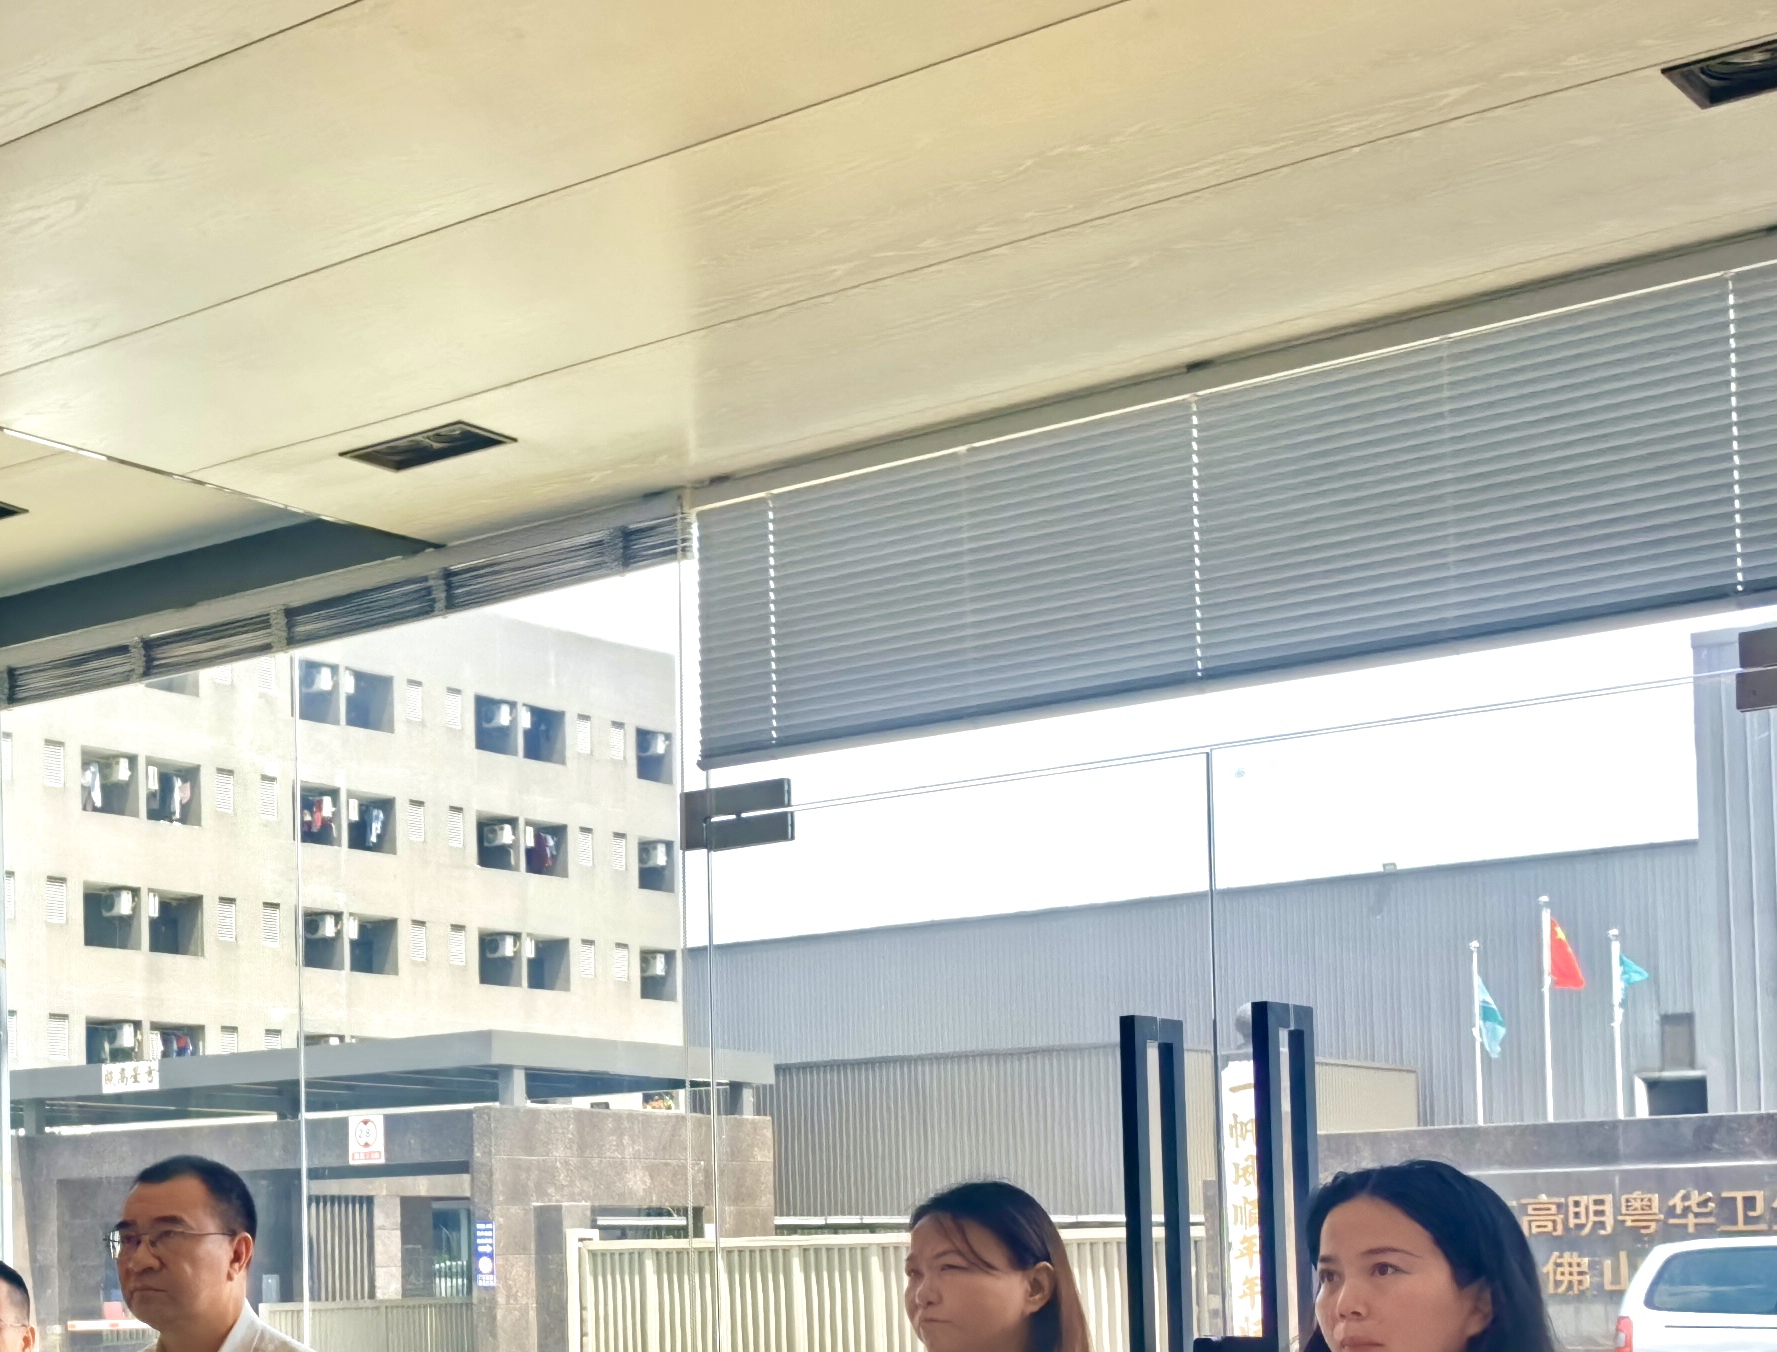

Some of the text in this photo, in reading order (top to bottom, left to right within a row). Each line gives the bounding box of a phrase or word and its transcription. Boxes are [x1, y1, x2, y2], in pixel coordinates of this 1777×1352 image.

[1509, 1190, 1777, 1237] 高明粤华卫
